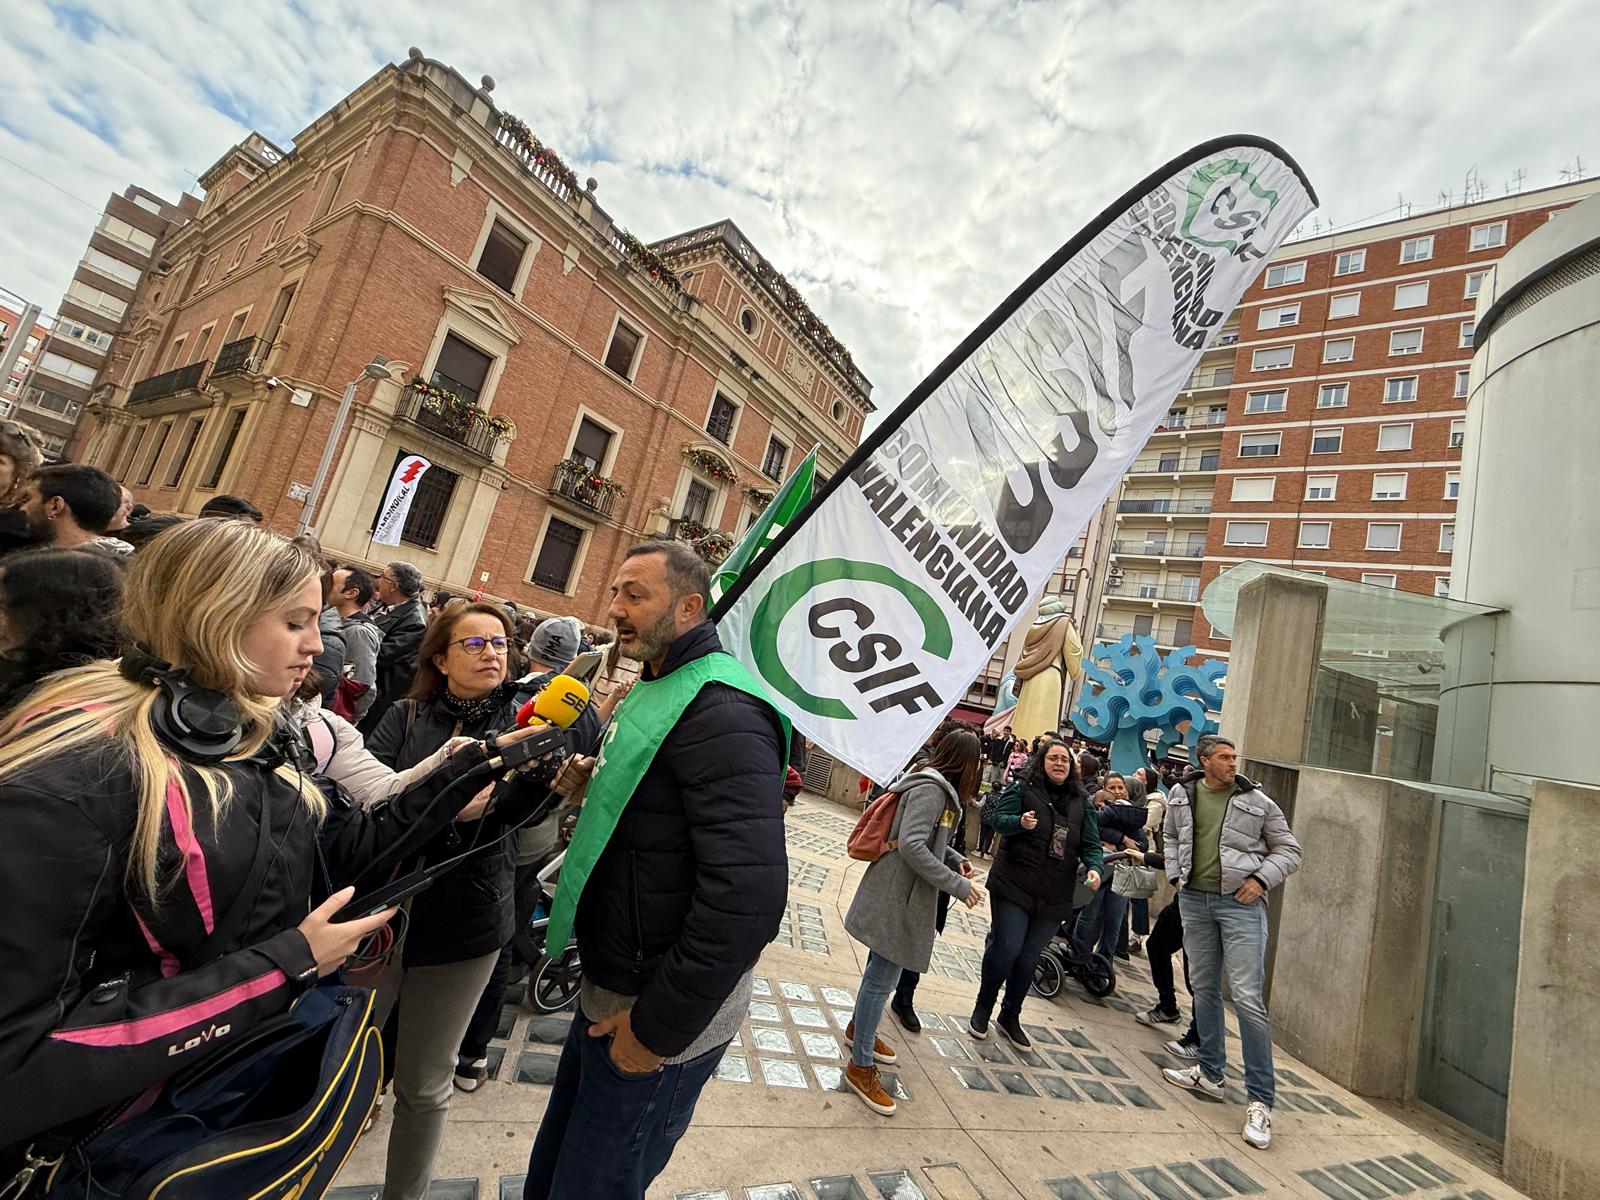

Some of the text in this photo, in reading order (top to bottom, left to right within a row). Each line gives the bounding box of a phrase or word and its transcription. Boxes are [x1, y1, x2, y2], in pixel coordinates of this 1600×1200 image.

[850, 455, 1007, 650] VALENCIANA
[877, 425, 1028, 615] COMUNIDAD
[540, 635, 562, 661] PUMA
[808, 597, 944, 715] CSIF
